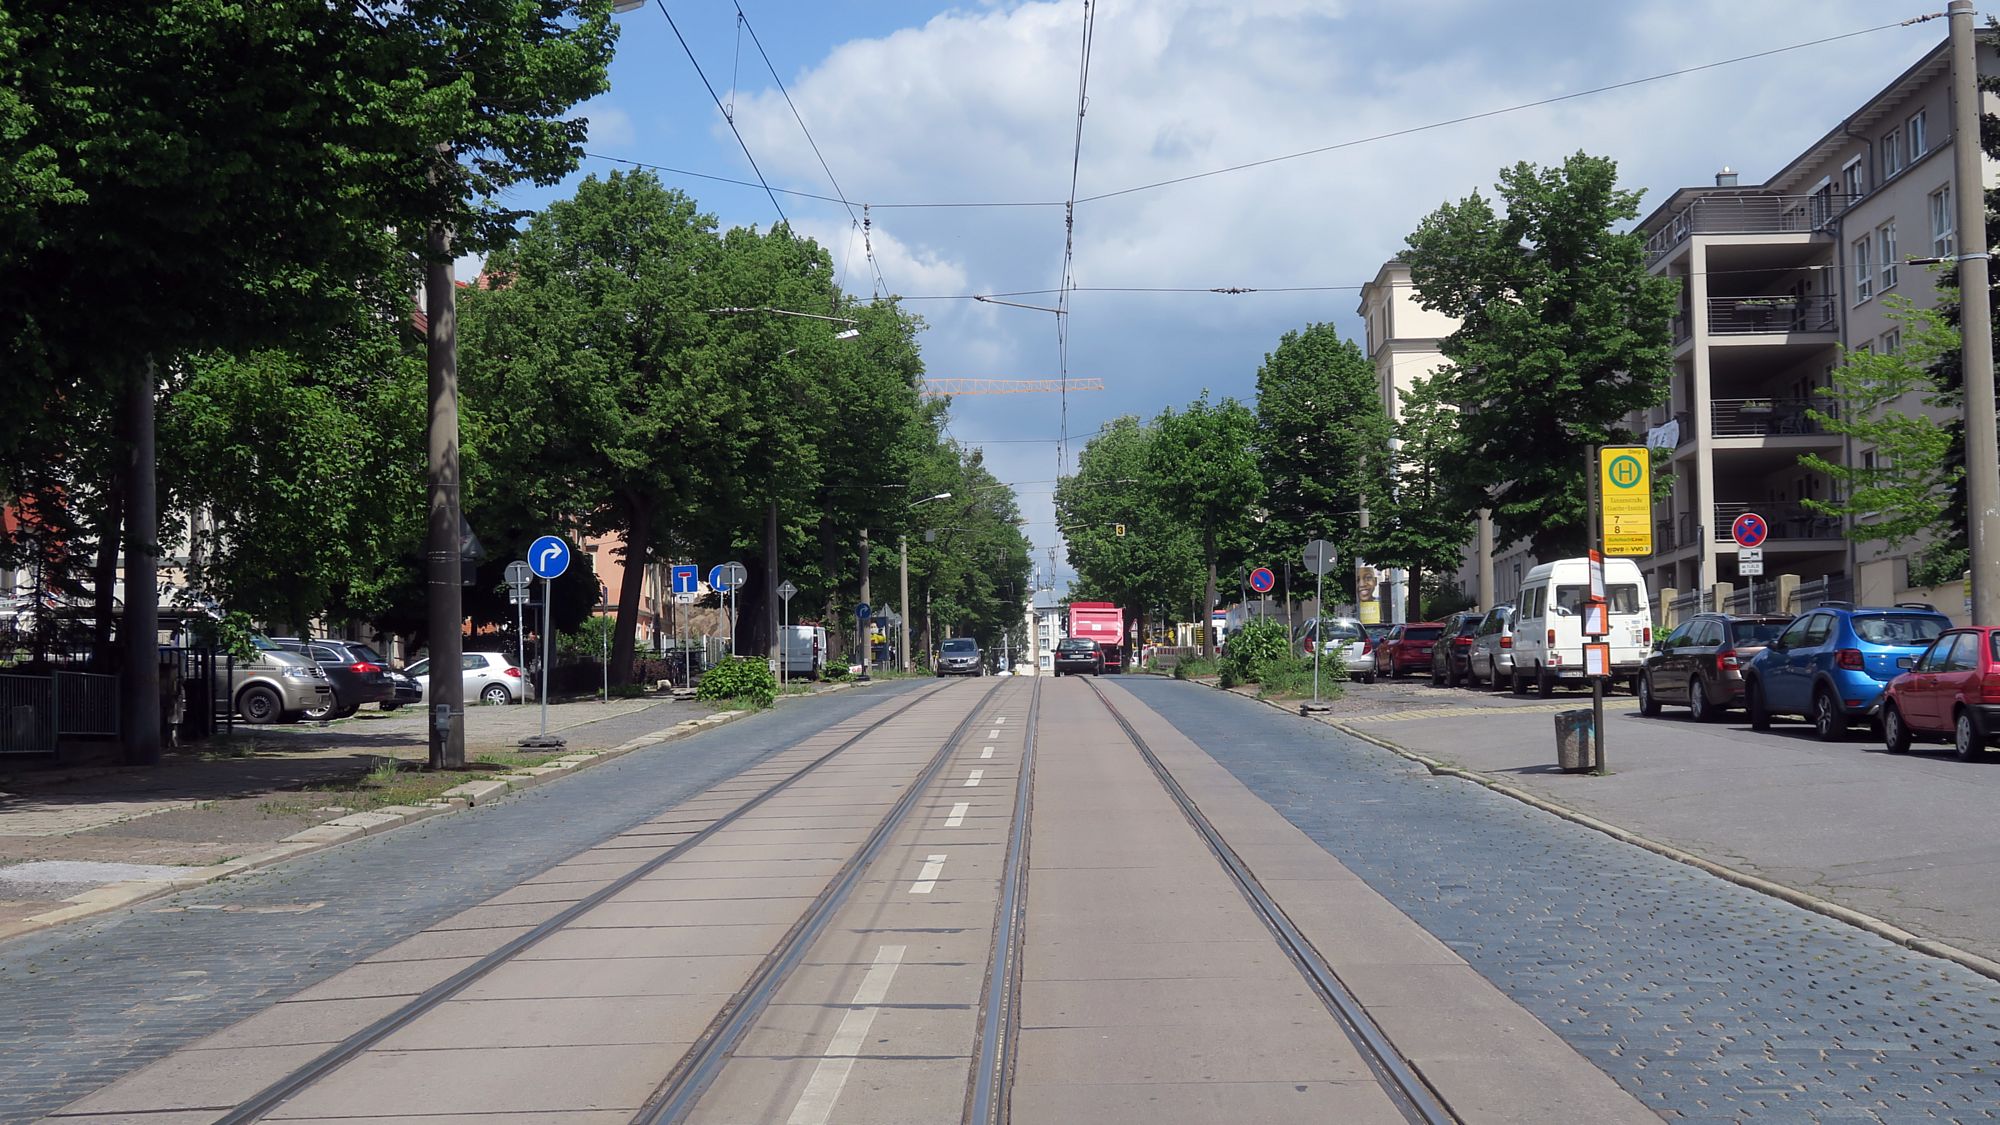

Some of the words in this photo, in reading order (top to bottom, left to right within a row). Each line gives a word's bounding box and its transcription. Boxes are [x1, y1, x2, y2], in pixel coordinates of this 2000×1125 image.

[1619, 463, 1632, 481] H
[1614, 515, 1620, 524] 7
[1614, 526, 1620, 534] 8
